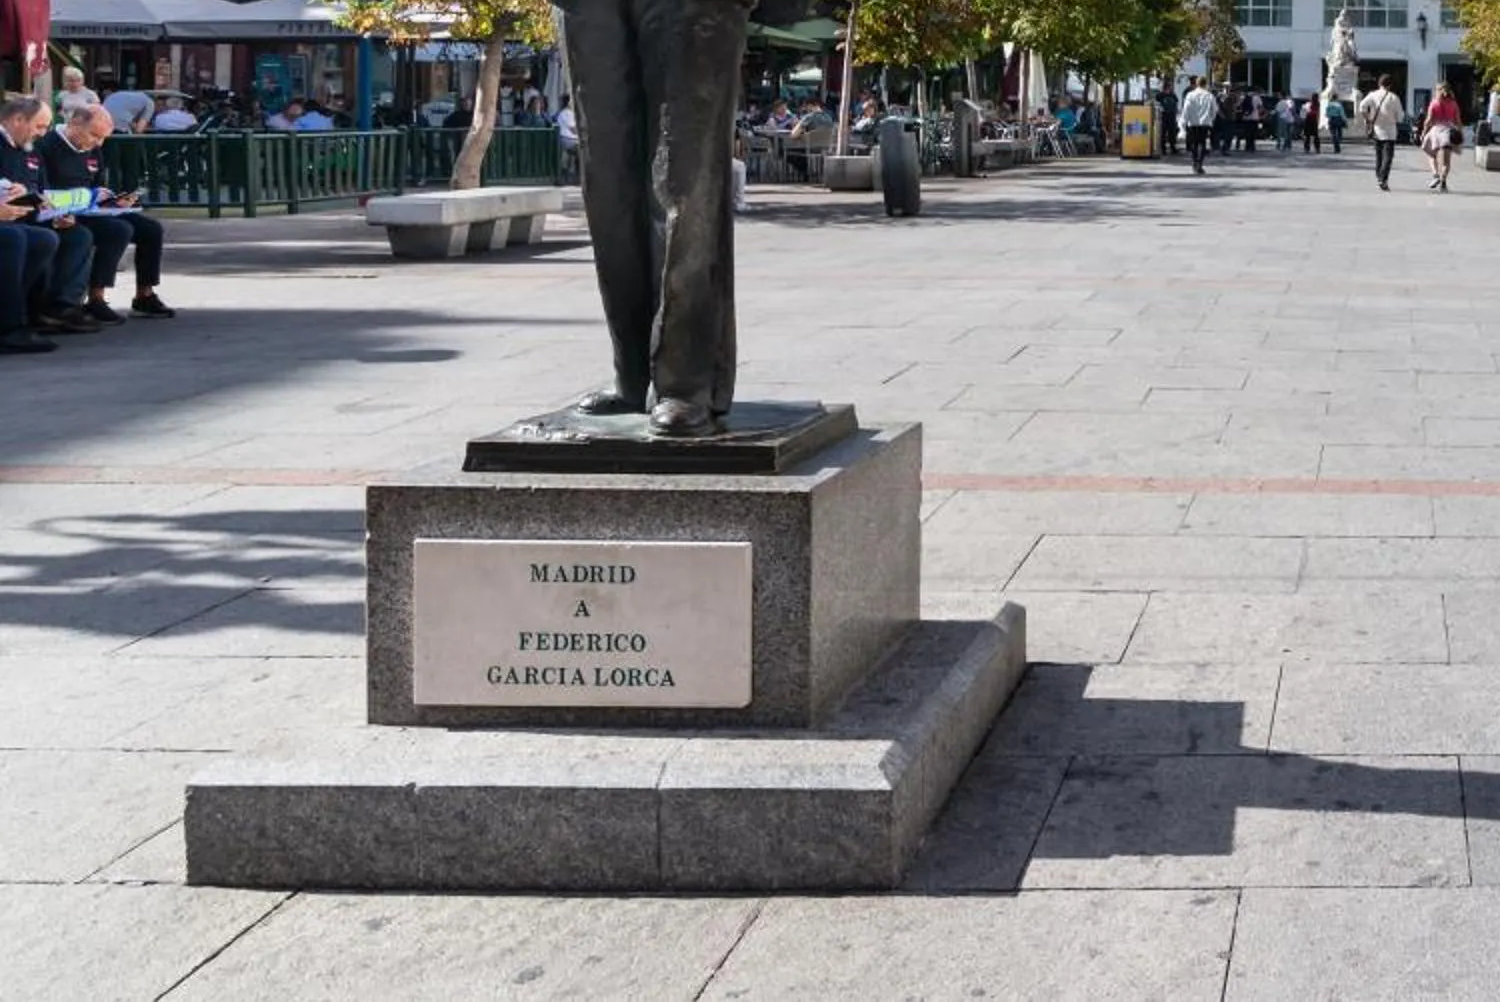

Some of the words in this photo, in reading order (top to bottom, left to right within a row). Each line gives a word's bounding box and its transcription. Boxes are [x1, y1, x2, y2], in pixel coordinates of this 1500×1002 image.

[530, 563, 636, 584] MADRID
[573, 600, 591, 617] A
[518, 631, 647, 652] FEDERICO
[487, 665, 586, 685] GARCIA
[594, 667, 676, 687] LORCA
